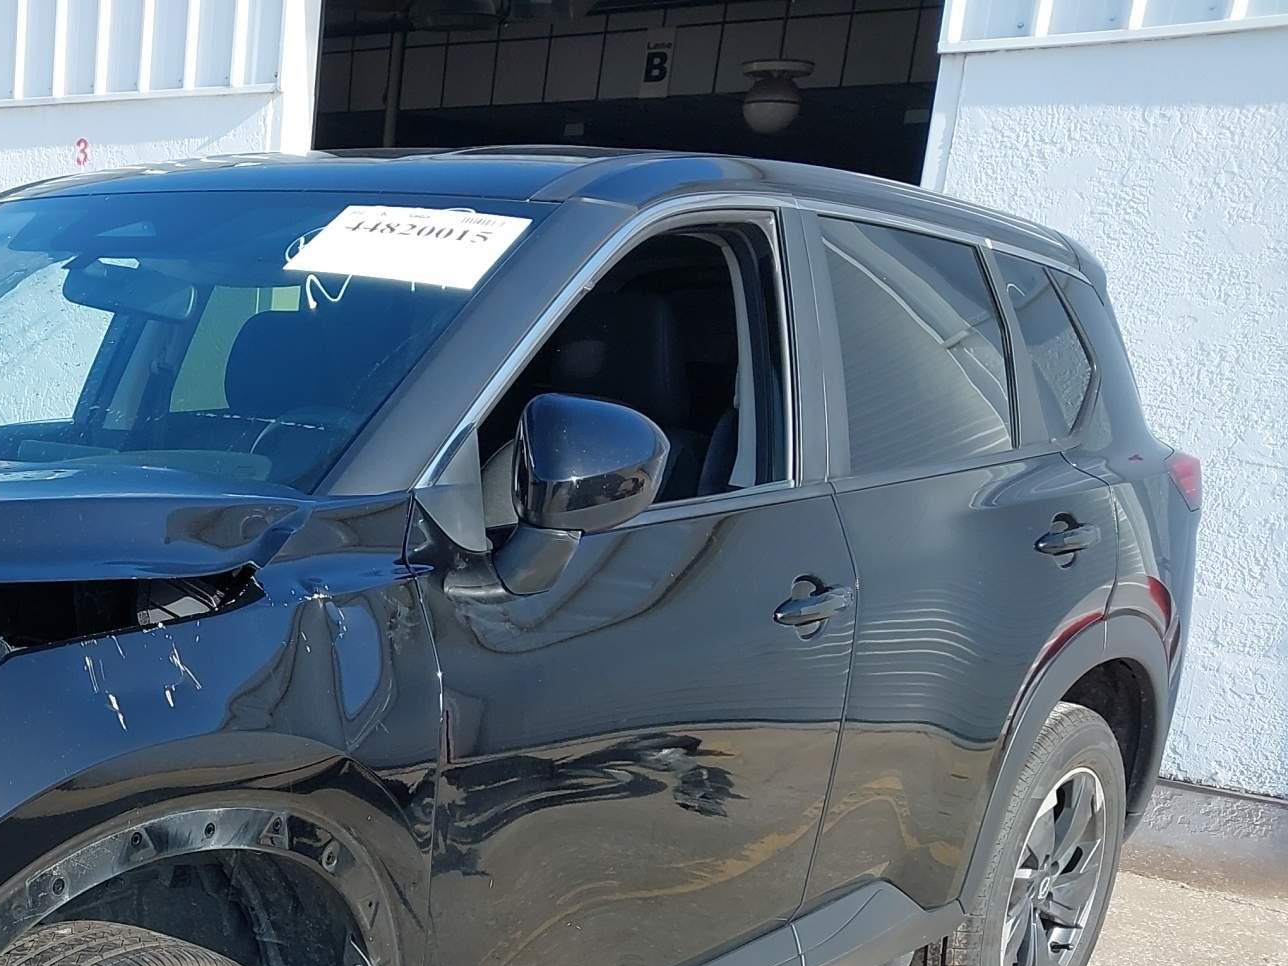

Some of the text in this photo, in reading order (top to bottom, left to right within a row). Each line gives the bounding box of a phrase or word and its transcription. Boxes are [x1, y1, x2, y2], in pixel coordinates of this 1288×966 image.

[643, 51, 668, 83] B
[76, 137, 89, 166] 3
[345, 220, 494, 244] 44820015
